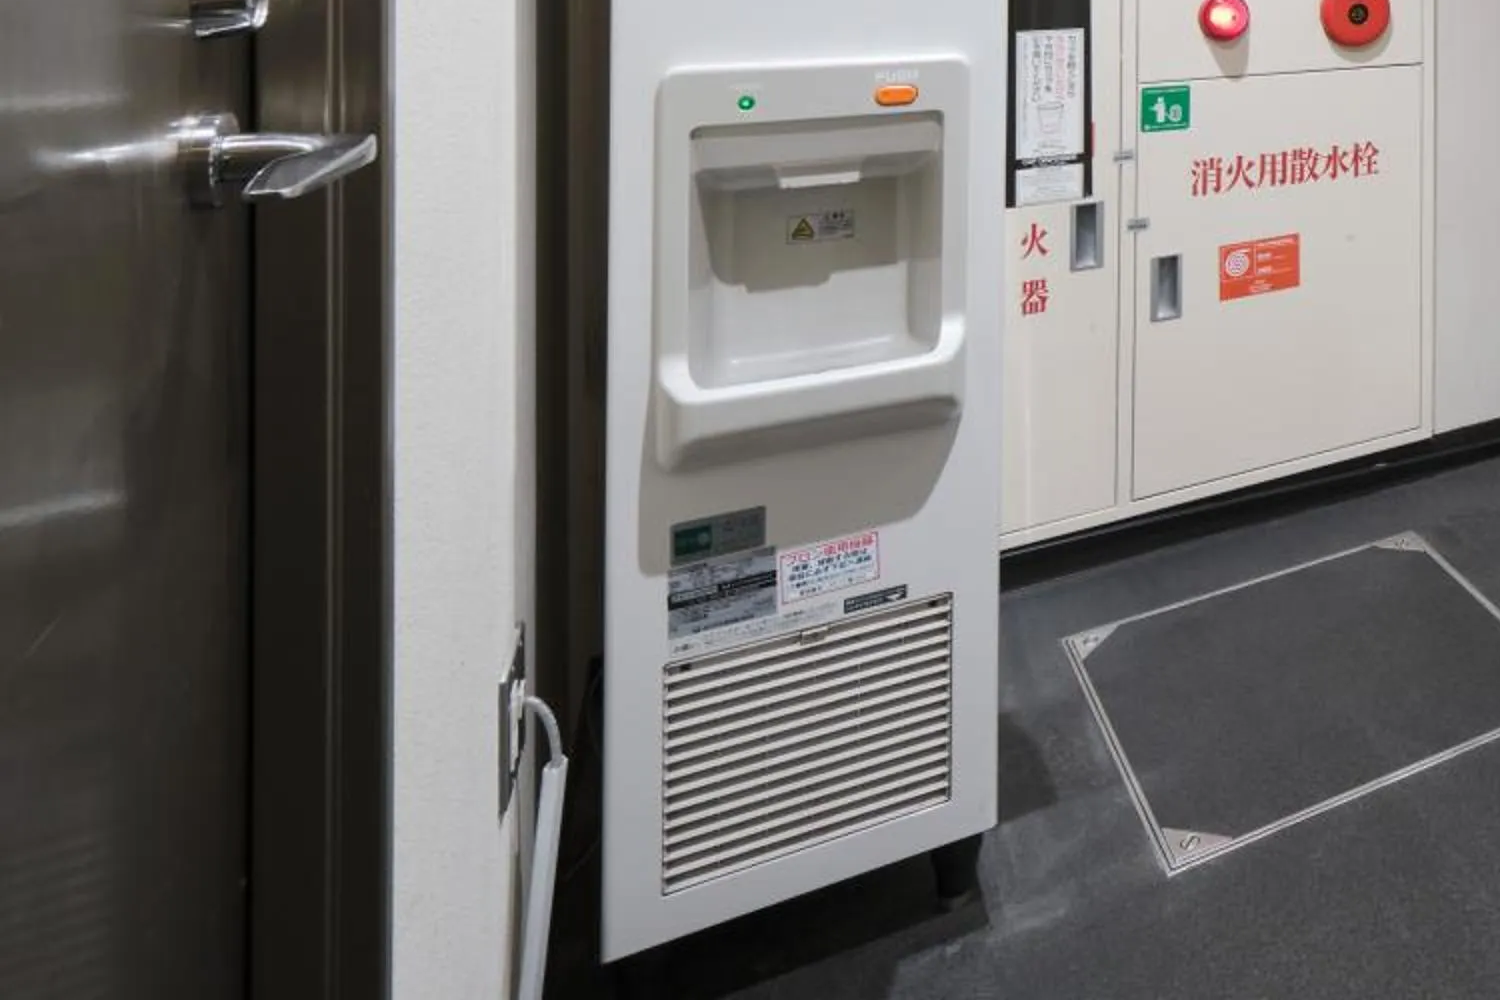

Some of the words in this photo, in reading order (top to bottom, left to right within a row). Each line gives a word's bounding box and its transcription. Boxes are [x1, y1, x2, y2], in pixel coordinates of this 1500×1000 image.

[1190, 141, 1380, 197] 消火用散水栓
[1020, 222, 1051, 317] 火器
